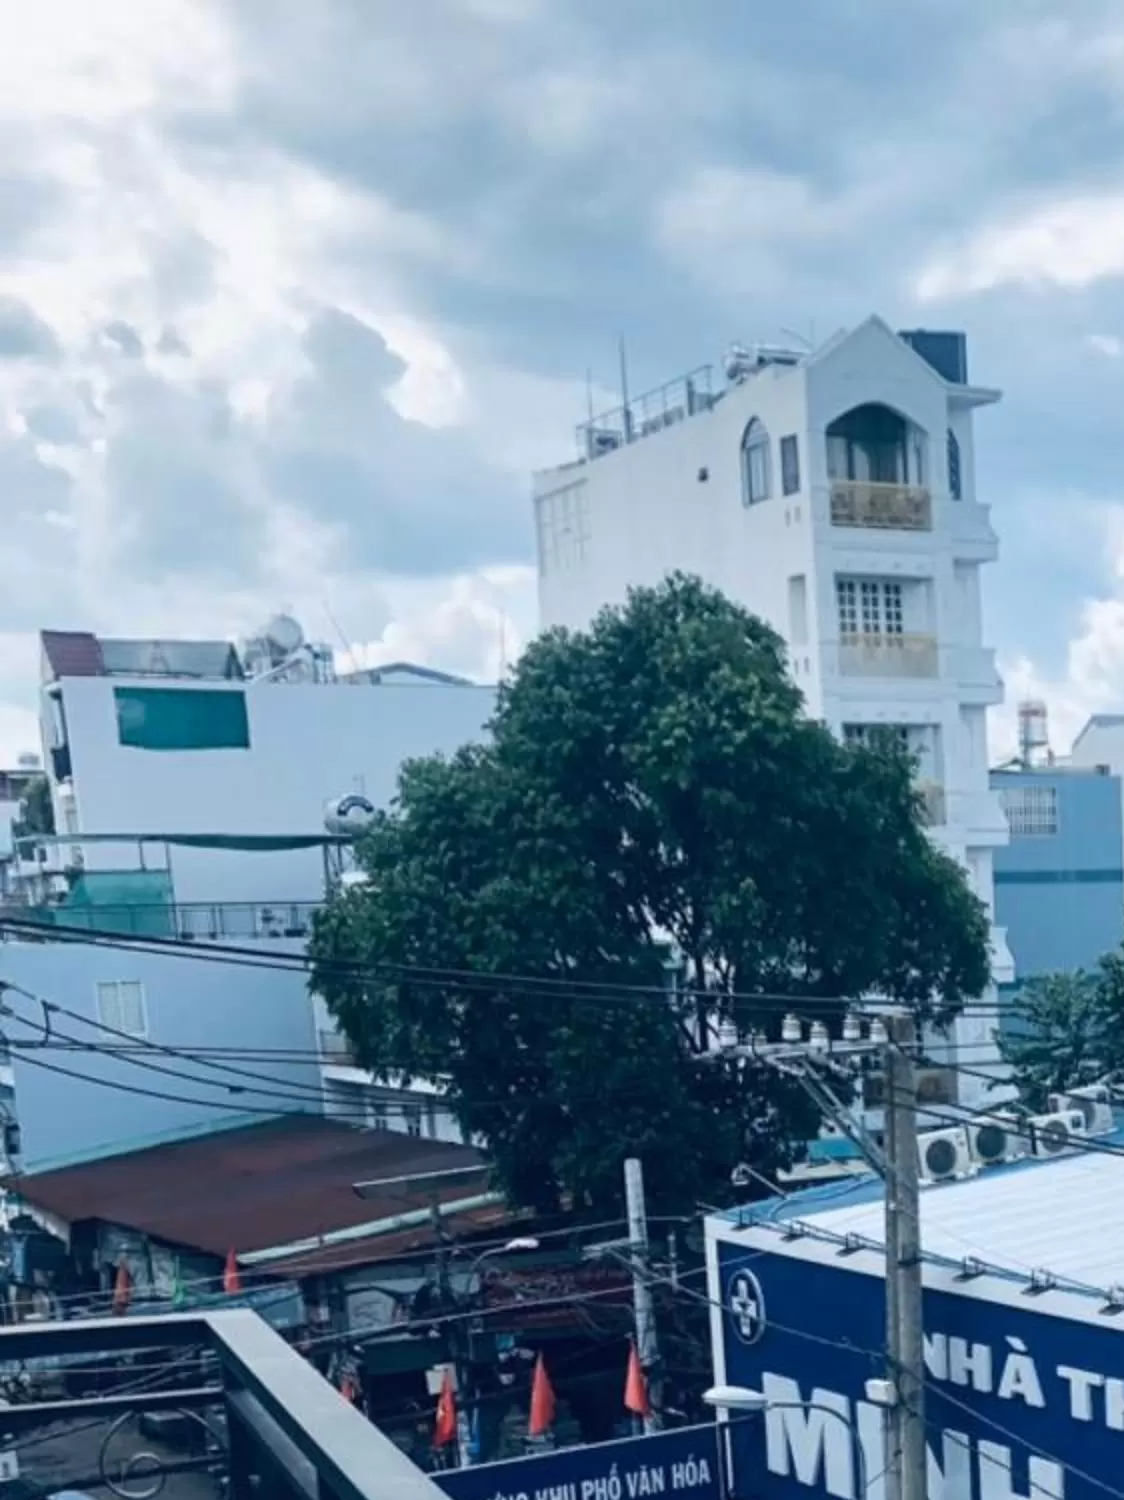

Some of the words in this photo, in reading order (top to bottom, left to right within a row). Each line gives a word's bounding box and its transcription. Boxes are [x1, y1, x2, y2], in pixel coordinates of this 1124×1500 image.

[922, 1332, 1046, 1408] NHÀ
[624, 1464, 665, 1500] VĂN
[671, 1452, 711, 1491] HÓA
